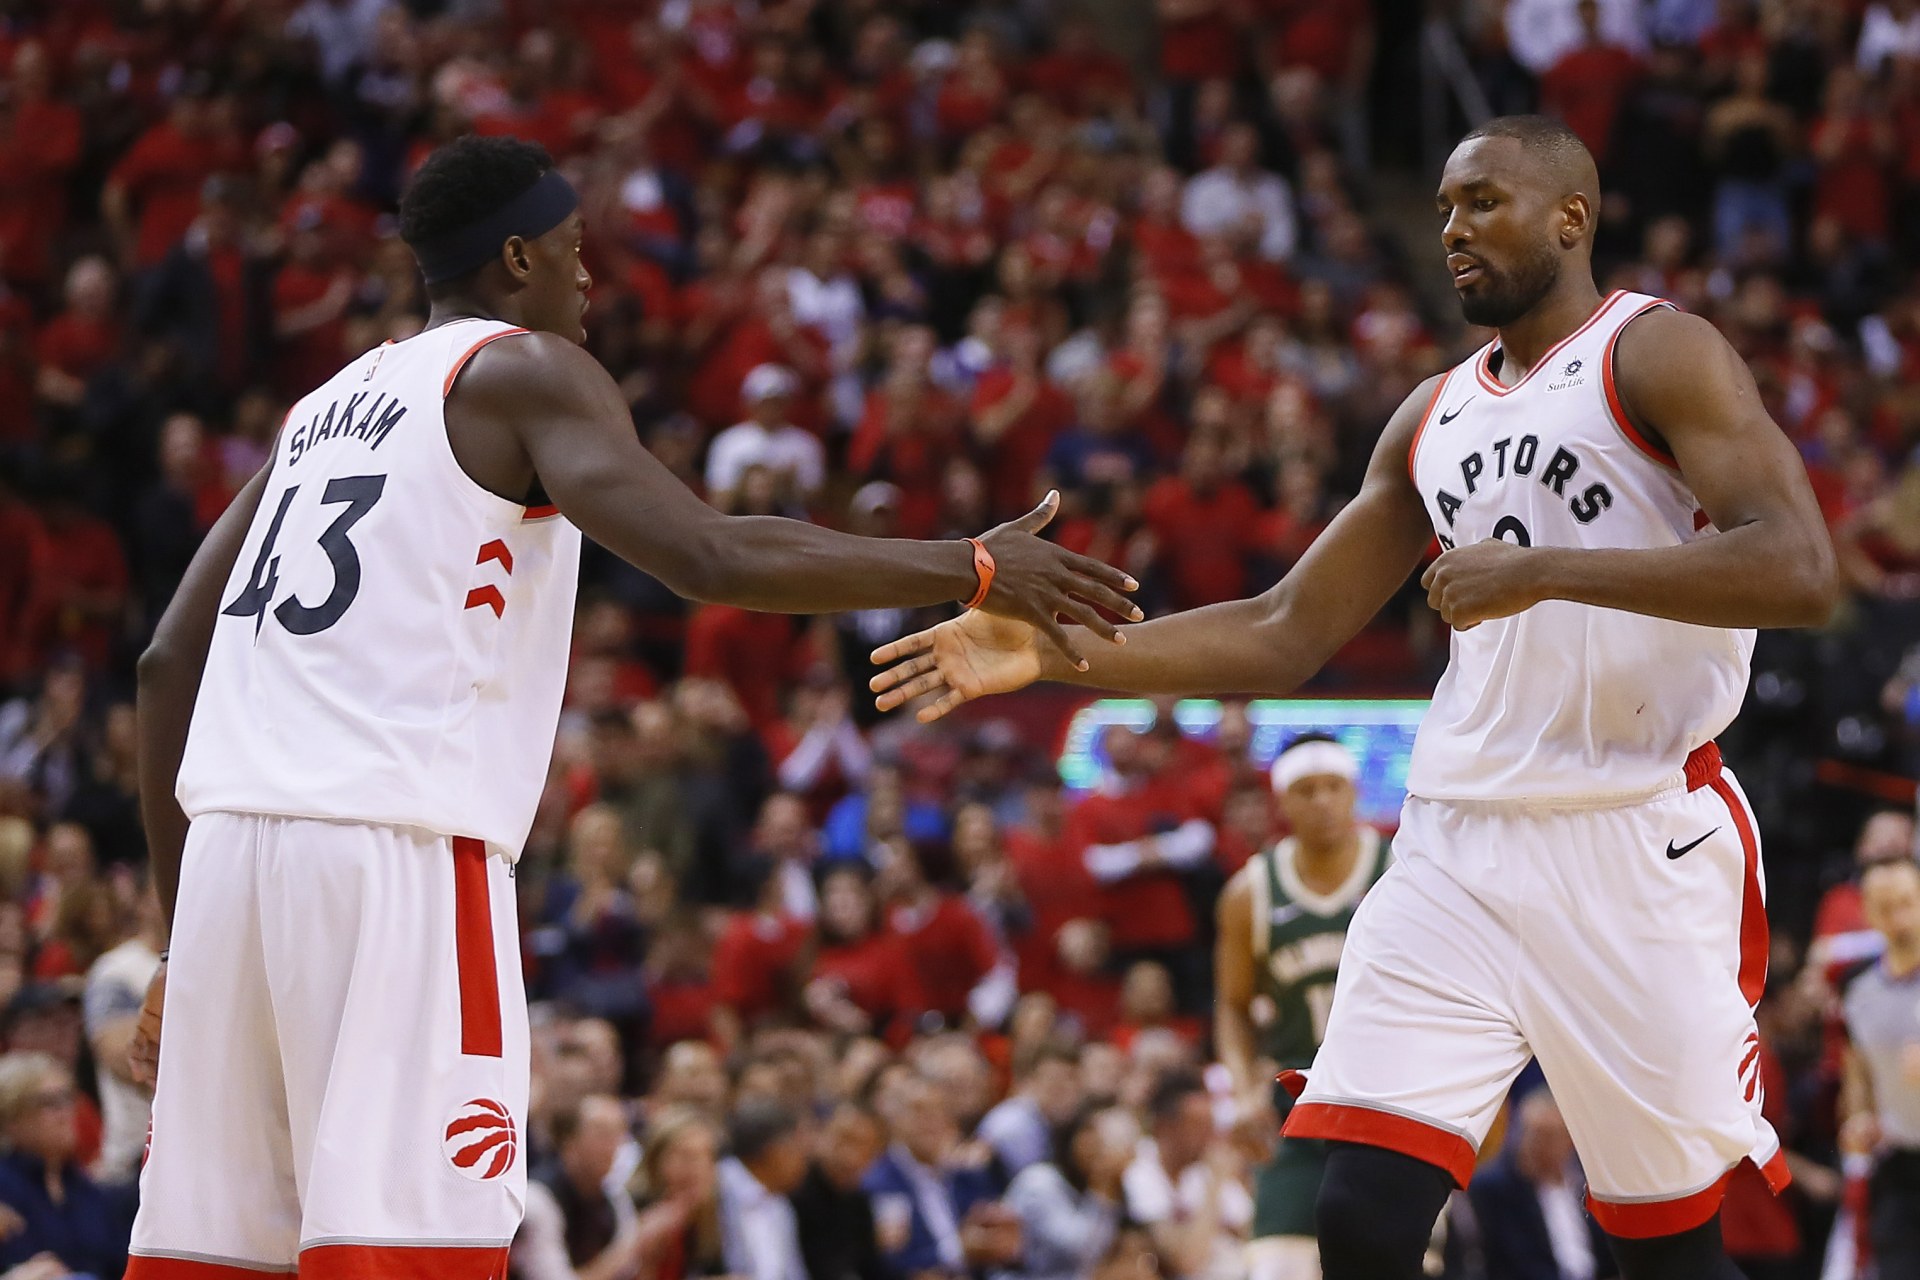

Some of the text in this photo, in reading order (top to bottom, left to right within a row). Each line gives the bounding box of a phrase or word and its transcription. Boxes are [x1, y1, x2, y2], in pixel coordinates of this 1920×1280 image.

[1546, 376, 1585, 392] Sun Life
[289, 391, 407, 466] SIAKAM
[221, 474, 387, 646] 43
